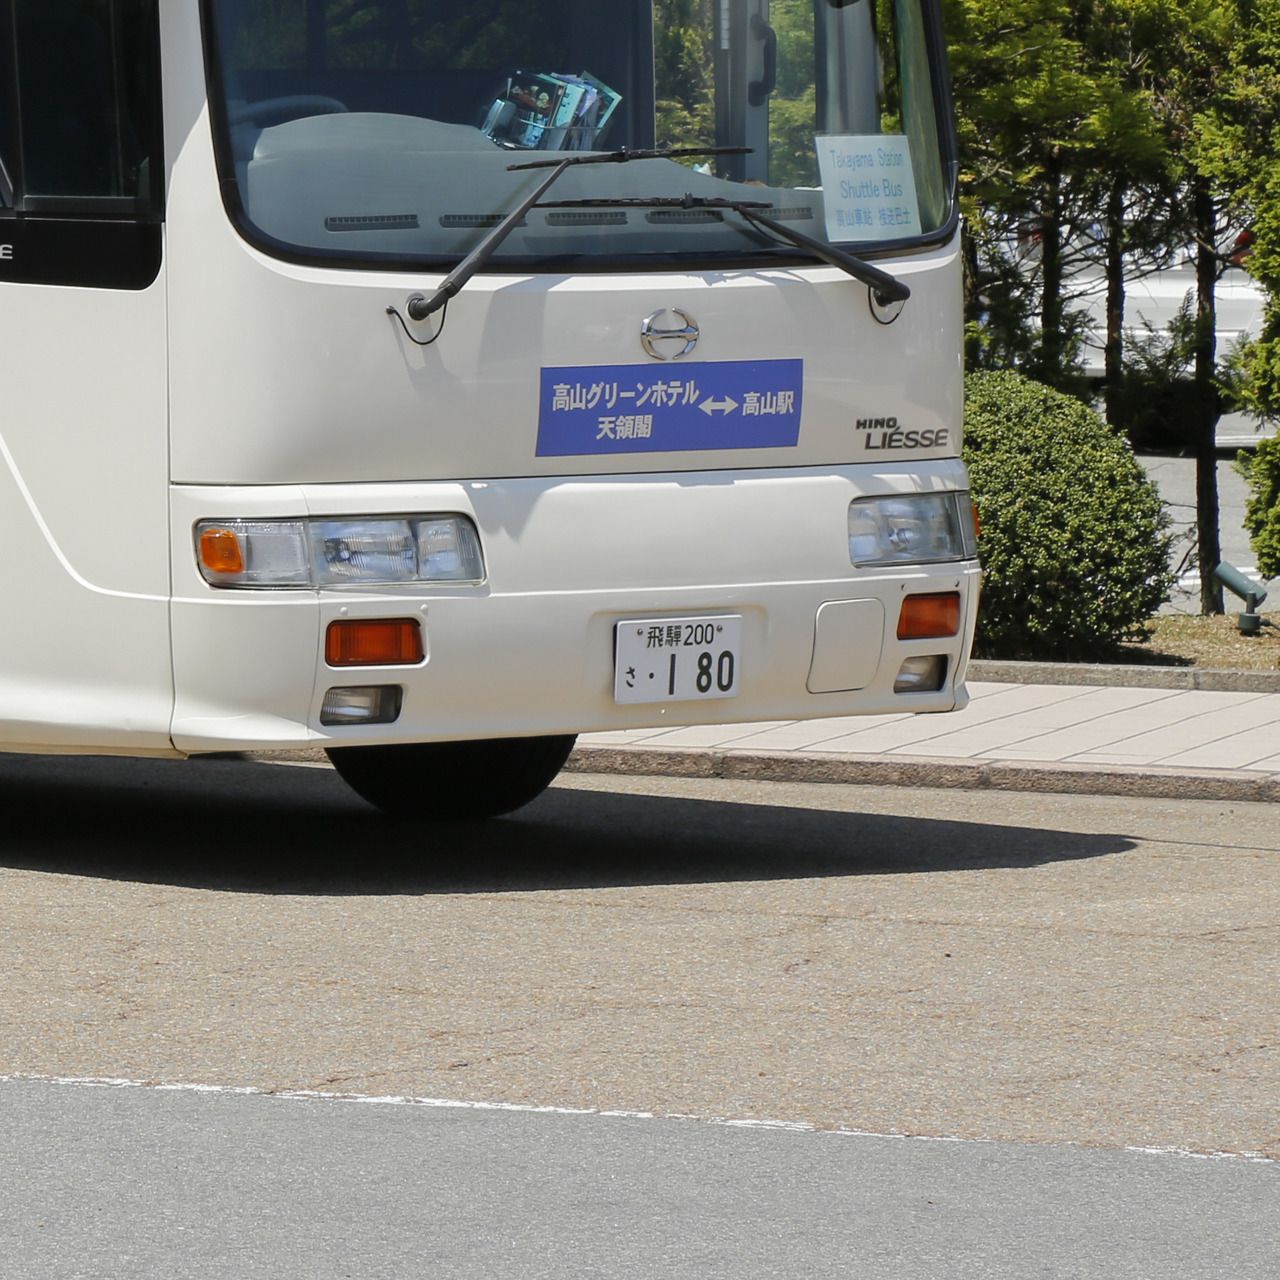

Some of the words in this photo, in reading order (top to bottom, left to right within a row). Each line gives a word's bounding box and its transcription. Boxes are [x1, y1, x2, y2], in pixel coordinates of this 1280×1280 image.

[829, 148, 874, 172] Takayama
[840, 179, 880, 199] Shuttle
[882, 178, 904, 198] Bus
[552, 380, 700, 412] 高山グリーンホテル
[742, 390, 795, 417] 高山駅
[595, 414, 653, 441] 天領閣
[856, 417, 897, 430] HINO
[864, 426, 949, 450] LIÉSSE
[625, 666, 636, 688] さ
